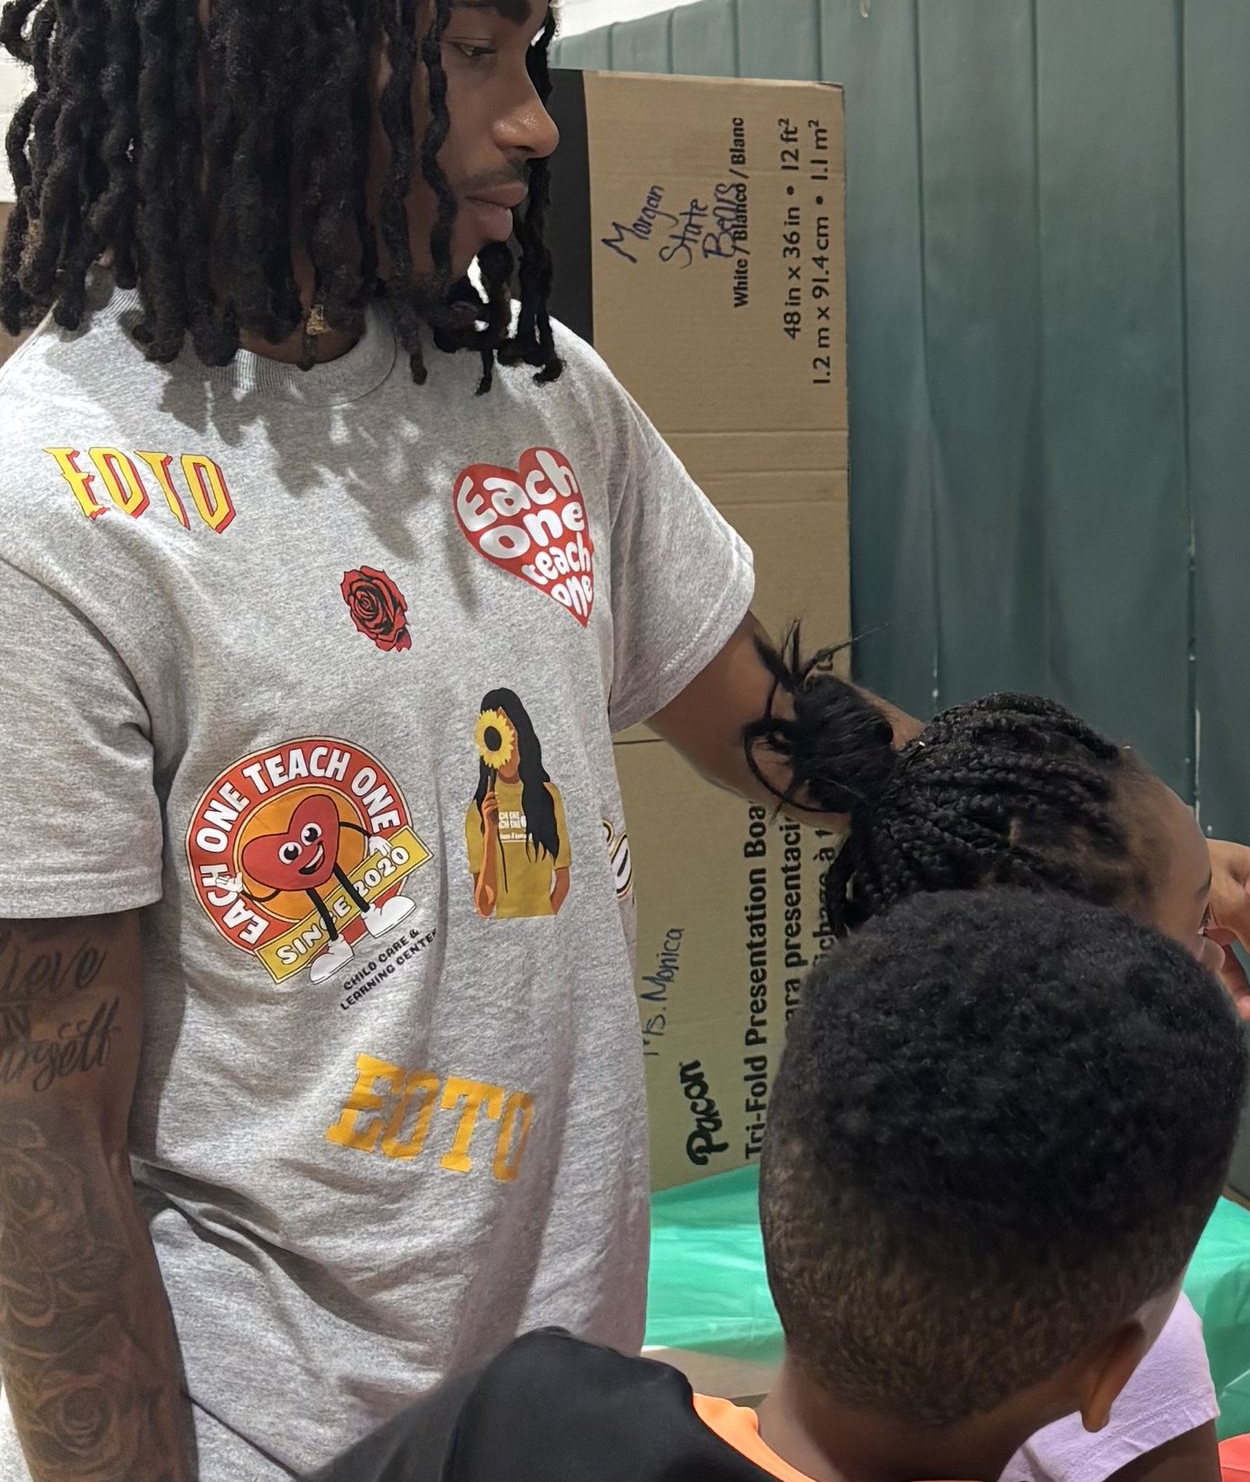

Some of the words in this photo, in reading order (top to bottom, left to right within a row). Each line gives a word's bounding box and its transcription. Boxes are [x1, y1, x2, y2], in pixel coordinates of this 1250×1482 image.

[731, 117, 746, 165] Blanc
[781, 148, 800, 171] 12
[810, 159, 828, 180] 1.1
[601, 184, 678, 263] Morgan
[659, 198, 708, 269] State
[731, 184, 748, 240] Blanco
[783, 207, 800, 227] in
[814, 216, 829, 251] cm
[783, 231, 800, 259] 36
[734, 259, 748, 308] White
[784, 287, 801, 306] in
[788, 267, 801, 280] x
[812, 255, 830, 299] 91.4
[784, 311, 801, 340] 48
[816, 327, 830, 348] m
[817, 307, 831, 320] x
[813, 355, 831, 384] 1.2
[457, 450, 578, 532] Each
[521, 532, 590, 585] reach
[551, 575, 593, 617] one
[243, 746, 351, 795] TEACH
[196, 781, 251, 853] ONE
[351, 766, 401, 834] ONE
[744, 801, 766, 858] Boa
[353, 846, 411, 899] 2020
[200, 863, 270, 945] EACH
[344, 961, 377, 990] CHILD
[378, 936, 409, 962] CARE
[641, 927, 685, 1002] Monica
[744, 868, 767, 1046] Presentation
[341, 964, 395, 1010] LEARNING
[324, 1052, 534, 1183] EOTO
[679, 1058, 730, 1166] Pacon
[744, 1055, 768, 1159] Tri-Fold
